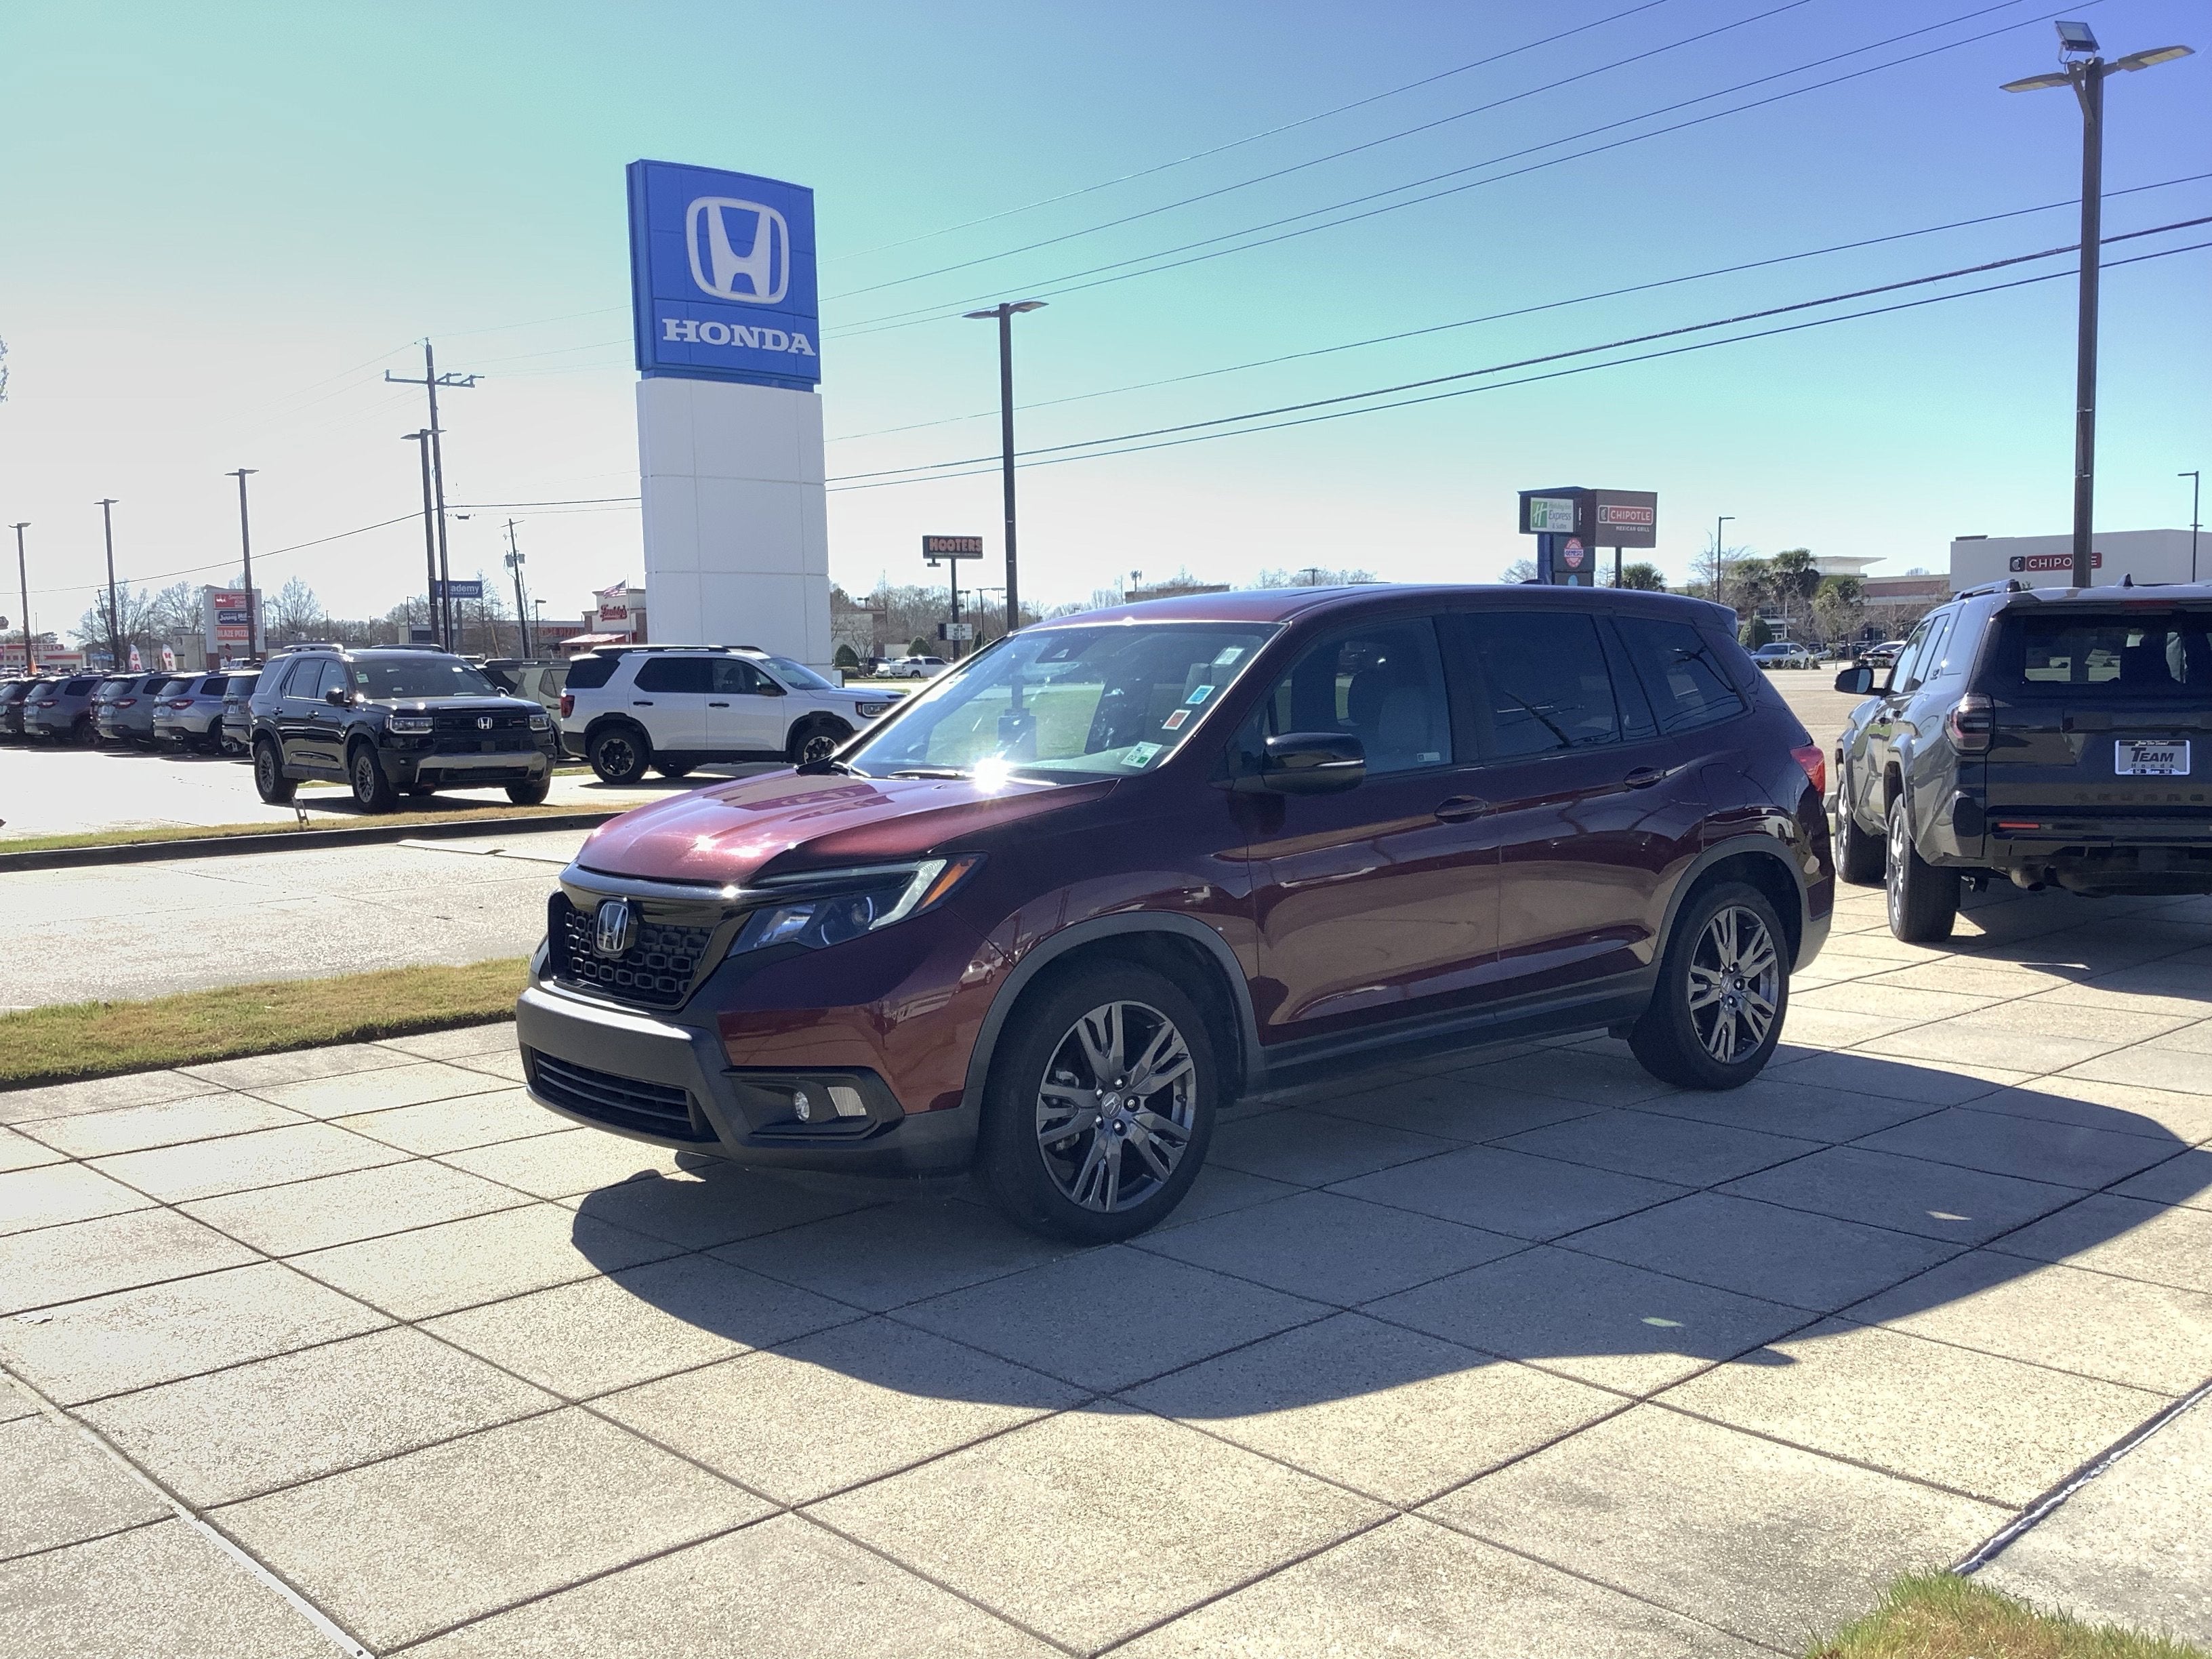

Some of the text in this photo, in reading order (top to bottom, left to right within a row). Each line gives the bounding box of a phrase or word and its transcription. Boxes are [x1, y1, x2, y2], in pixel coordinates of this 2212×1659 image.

[661, 318, 816, 356] HONDA
[1549, 510, 1572, 522] Express
[1610, 510, 1651, 521] CHIPOTLE
[929, 538, 982, 552] HOOTERS
[2029, 556, 2097, 568] CHIPOE
[439, 584, 479, 594] ademy
[217, 630, 249, 638] BLAZE PIZZ
[2131, 747, 2174, 762] TEAM
